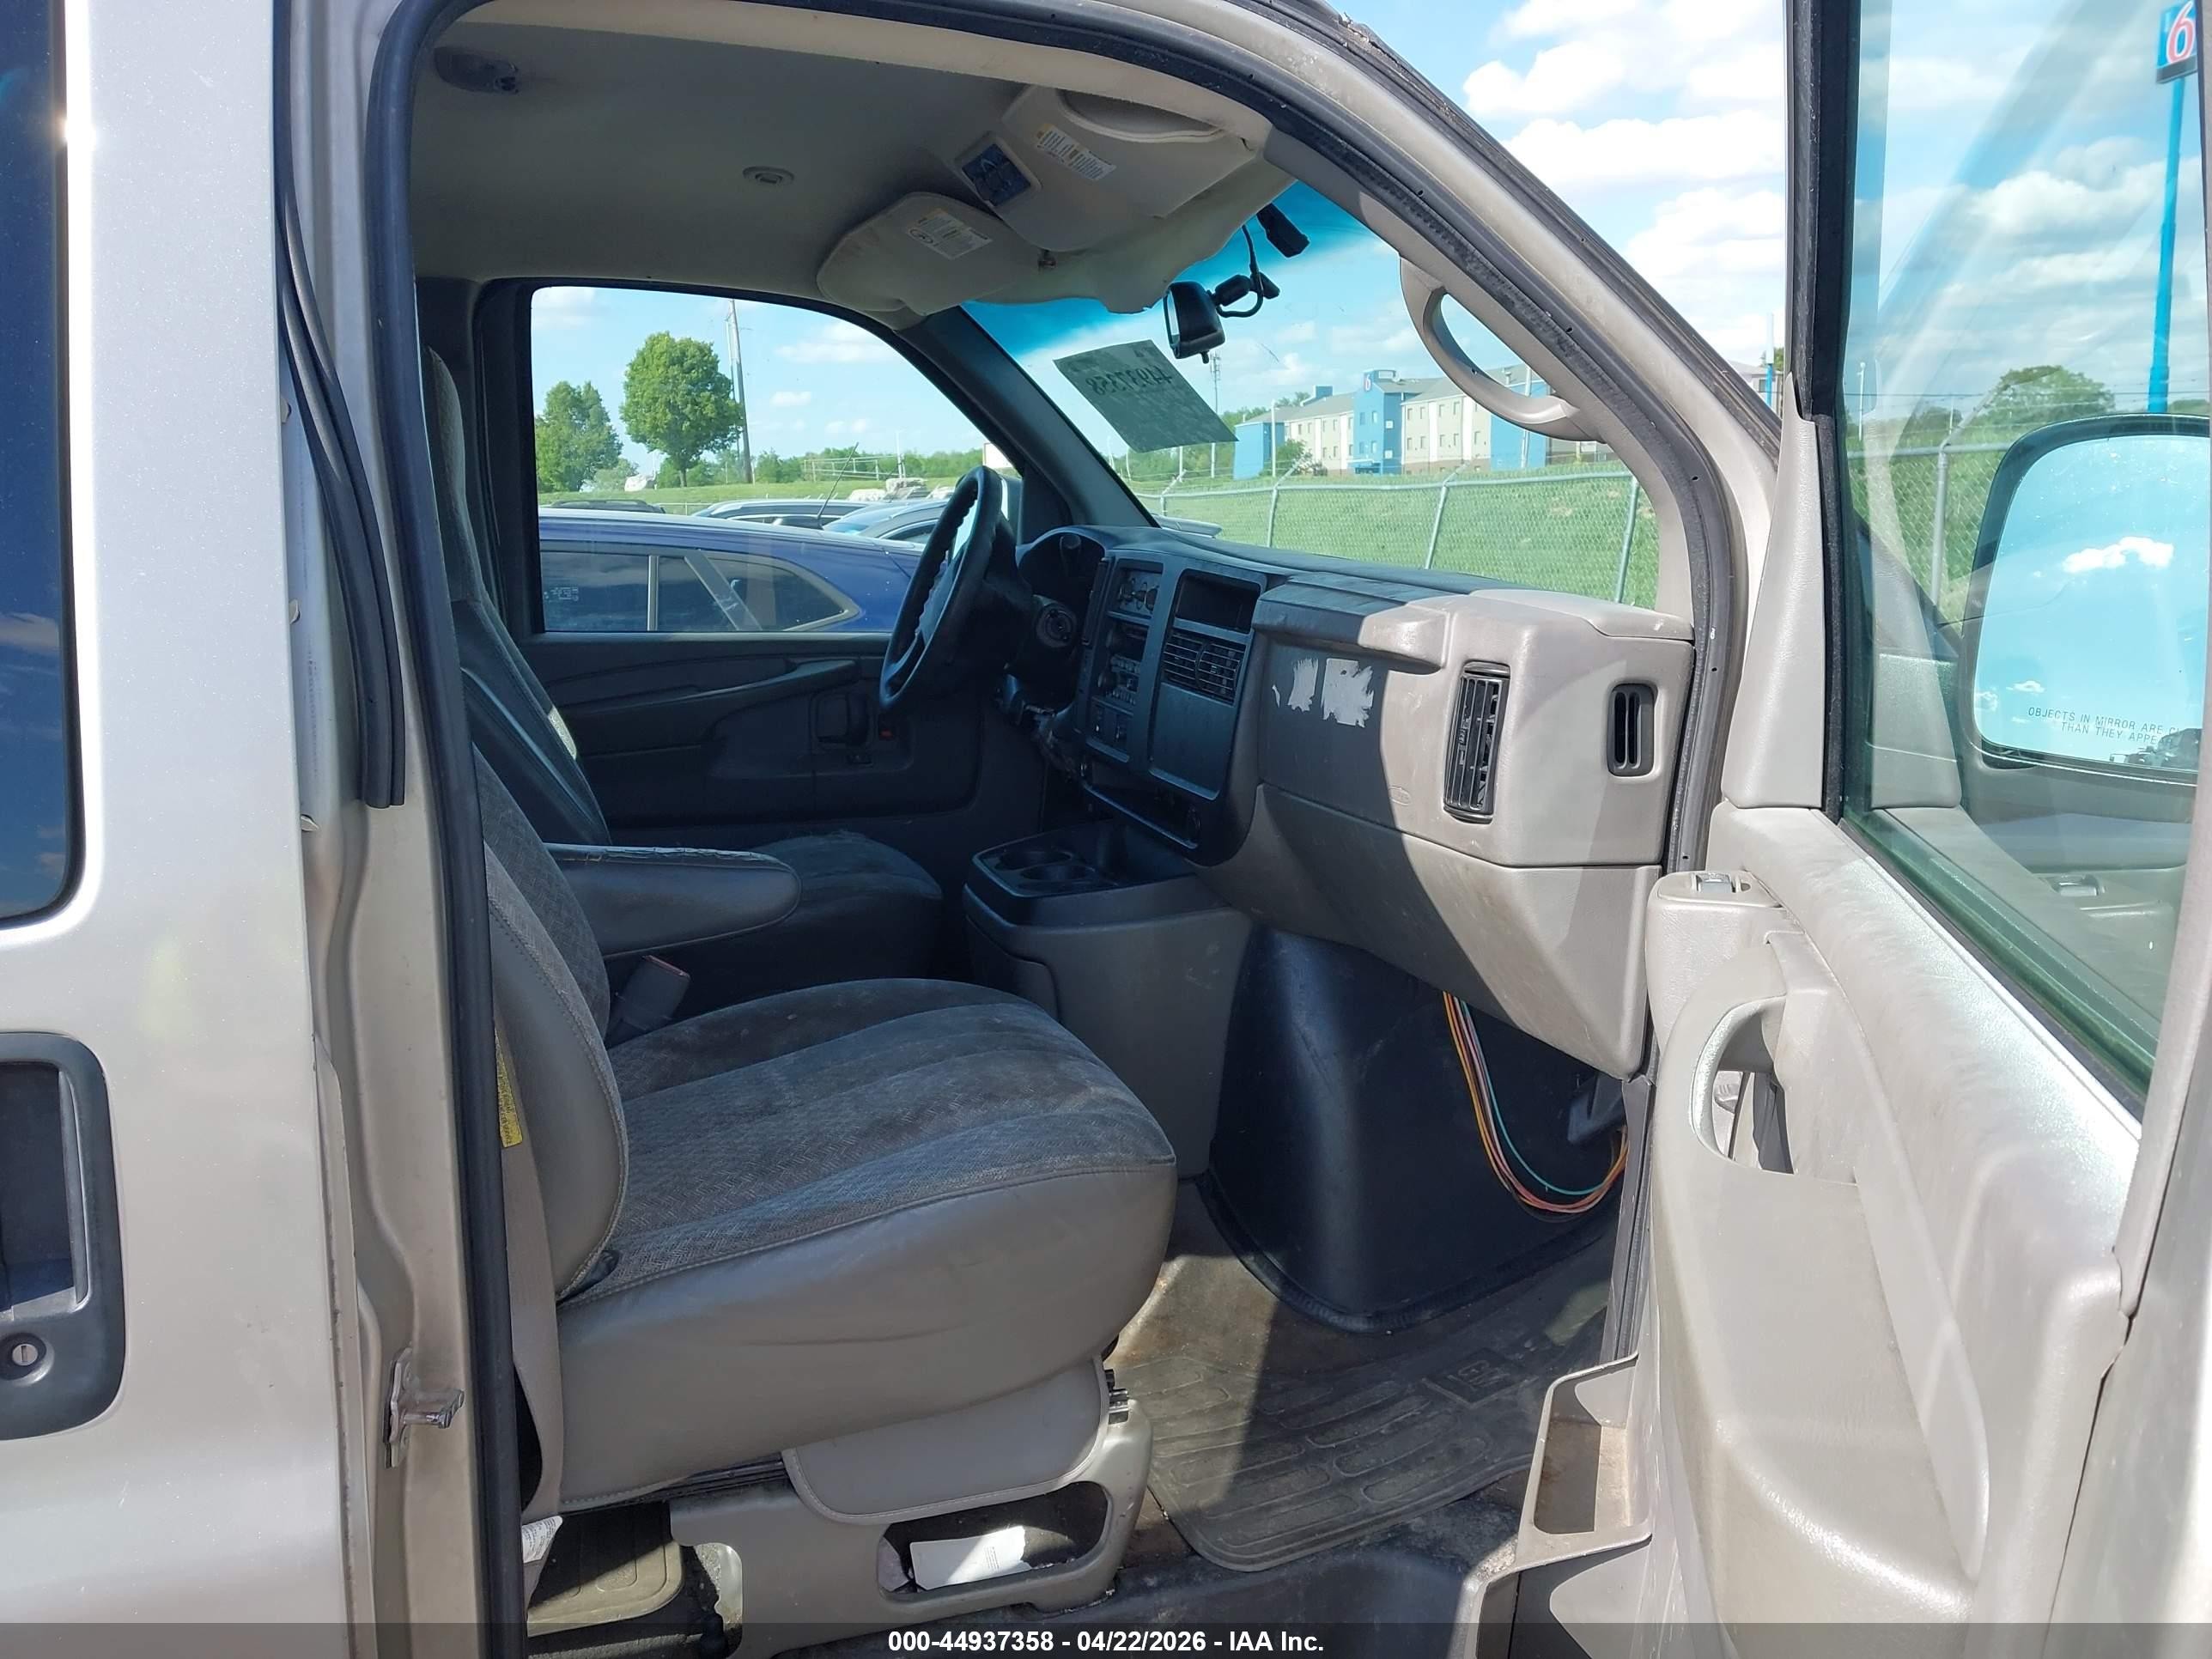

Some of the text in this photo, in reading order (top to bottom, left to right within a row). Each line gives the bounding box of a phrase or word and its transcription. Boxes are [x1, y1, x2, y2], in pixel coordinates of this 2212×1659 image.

[2166, 1, 2196, 64] 6
[1364, 374, 1372, 392] 6
[2028, 707, 2075, 721] OBJECTS
[2081, 714, 2090, 723] IN
[2095, 716, 2136, 730] MIRROR
[2141, 723, 2164, 735] ARE
[2062, 722, 2089, 734] THAN
[2095, 727, 2123, 739] THEY
